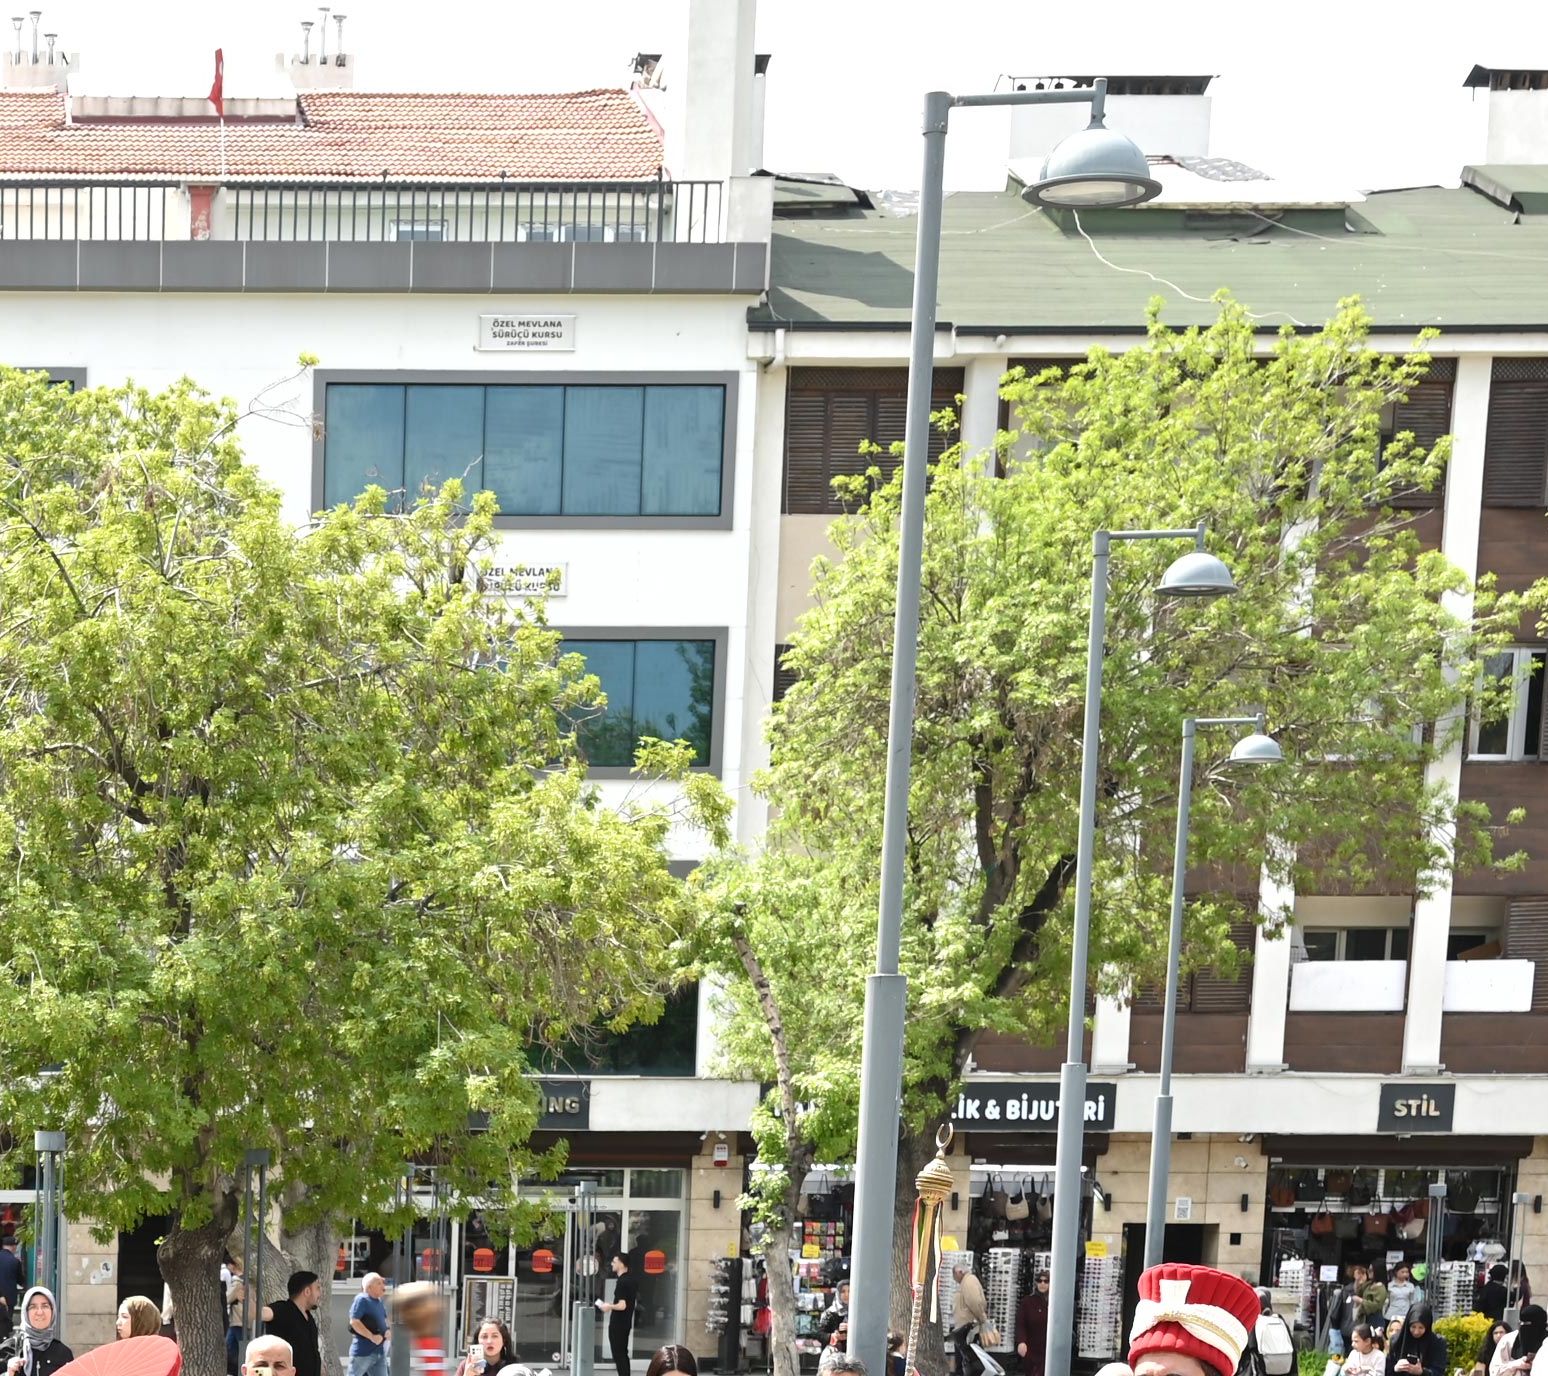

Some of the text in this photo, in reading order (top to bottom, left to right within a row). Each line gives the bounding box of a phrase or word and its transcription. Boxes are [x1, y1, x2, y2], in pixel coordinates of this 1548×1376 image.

[492, 318, 563, 328] ÖZEL MEVLANA
[531, 331, 563, 339] KURSU
[509, 567, 556, 577] MEVLAN
[984, 1100, 1002, 1121] &
[1005, 1093, 1106, 1122] BİJURİ
[1394, 1093, 1441, 1117] STİL
